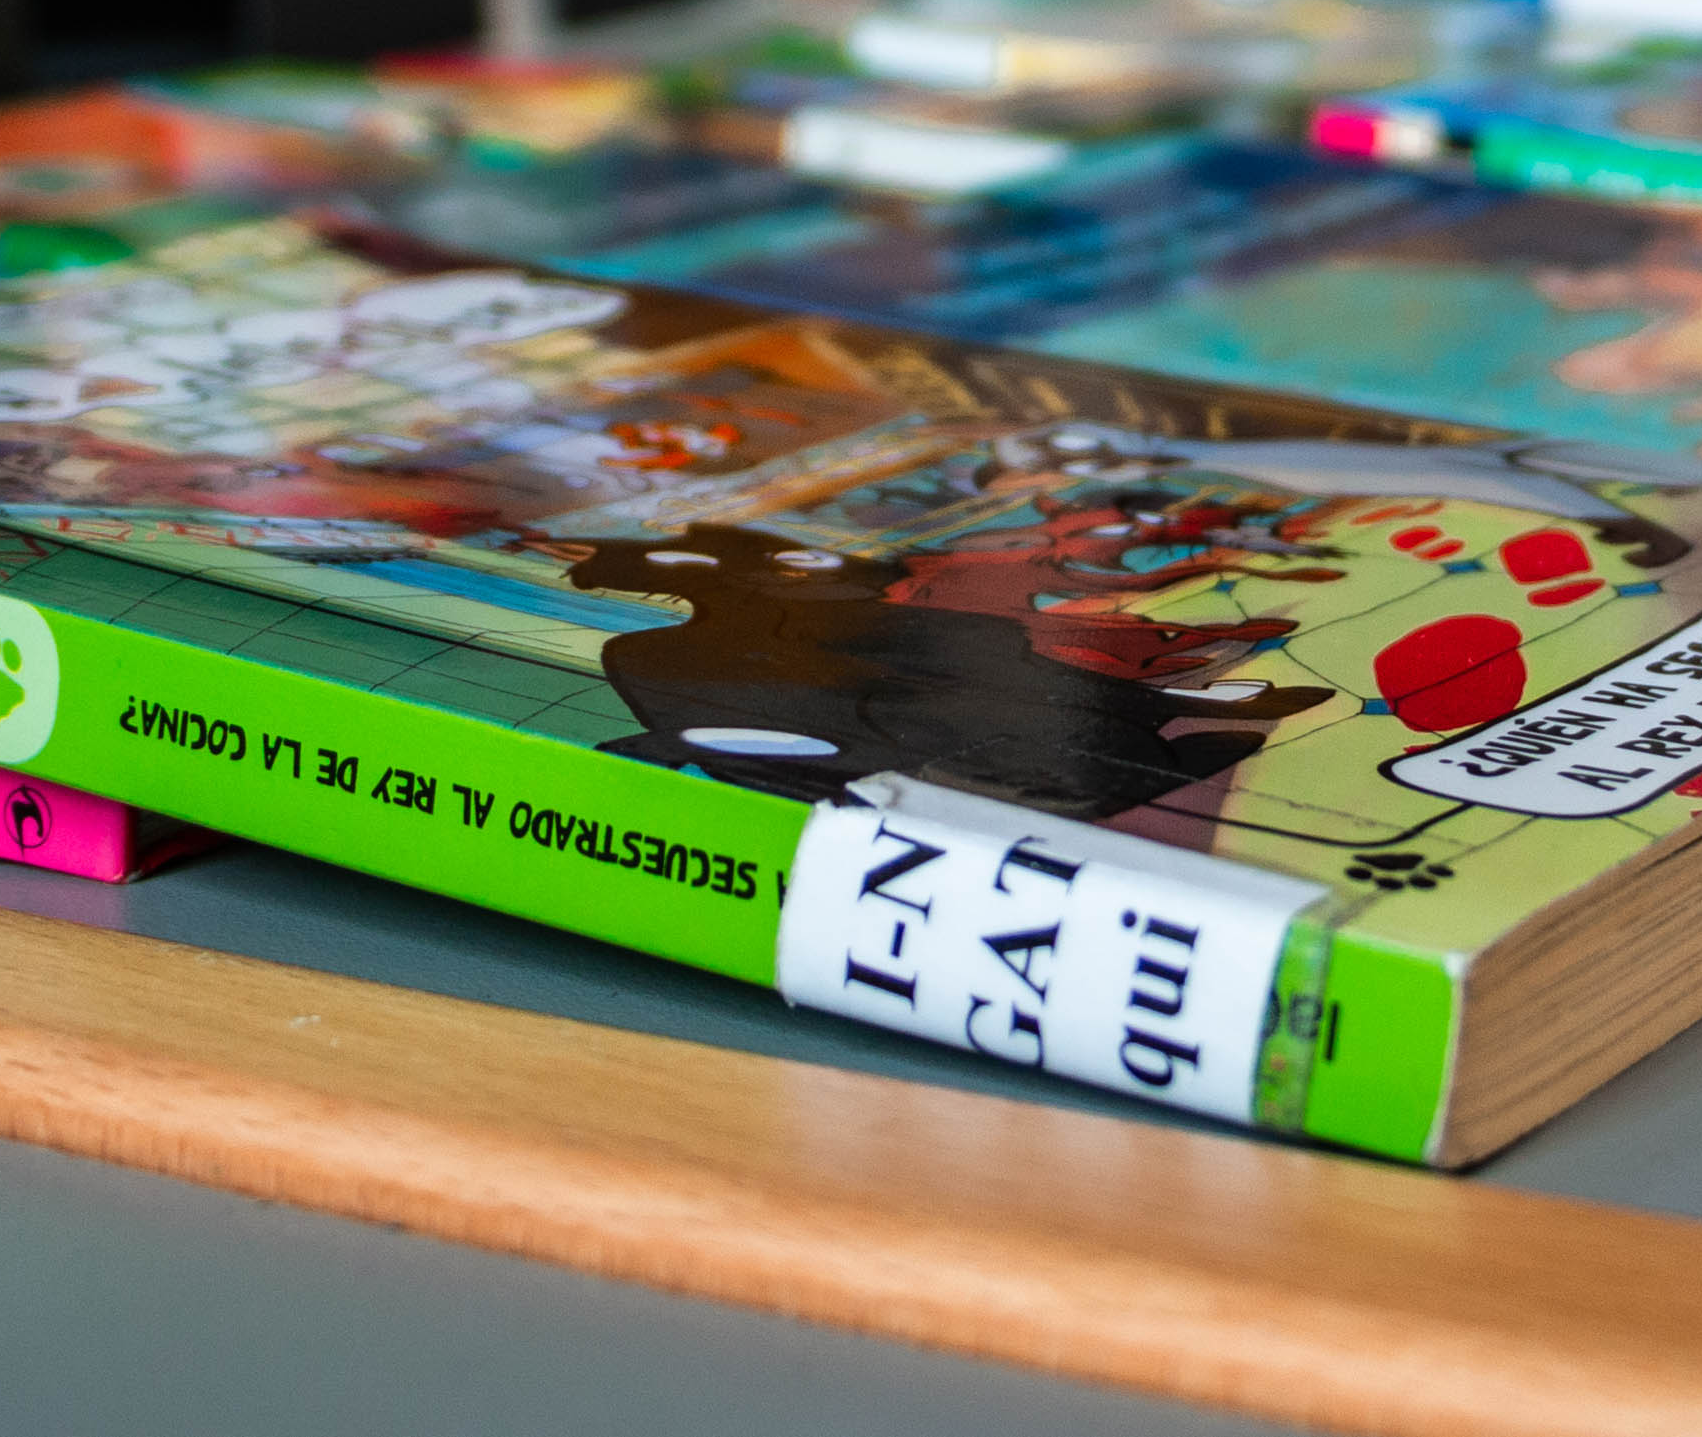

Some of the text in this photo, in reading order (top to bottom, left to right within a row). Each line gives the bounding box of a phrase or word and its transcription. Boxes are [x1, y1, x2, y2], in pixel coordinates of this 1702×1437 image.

[119, 695, 246, 761] COCINA?
[262, 732, 302, 779] LA
[1440, 708, 1617, 778] ¿QUIÉN
[1581, 681, 1678, 710] HA
[315, 747, 359, 794] DE
[371, 766, 437, 815] REY
[1556, 764, 1655, 792] AL
[452, 783, 495, 829] AL
[508, 800, 758, 900] SECUESTRADO
[843, 817, 948, 1011] I-N
[964, 835, 1087, 1069] GAT
[1117, 906, 1200, 1090] qui
